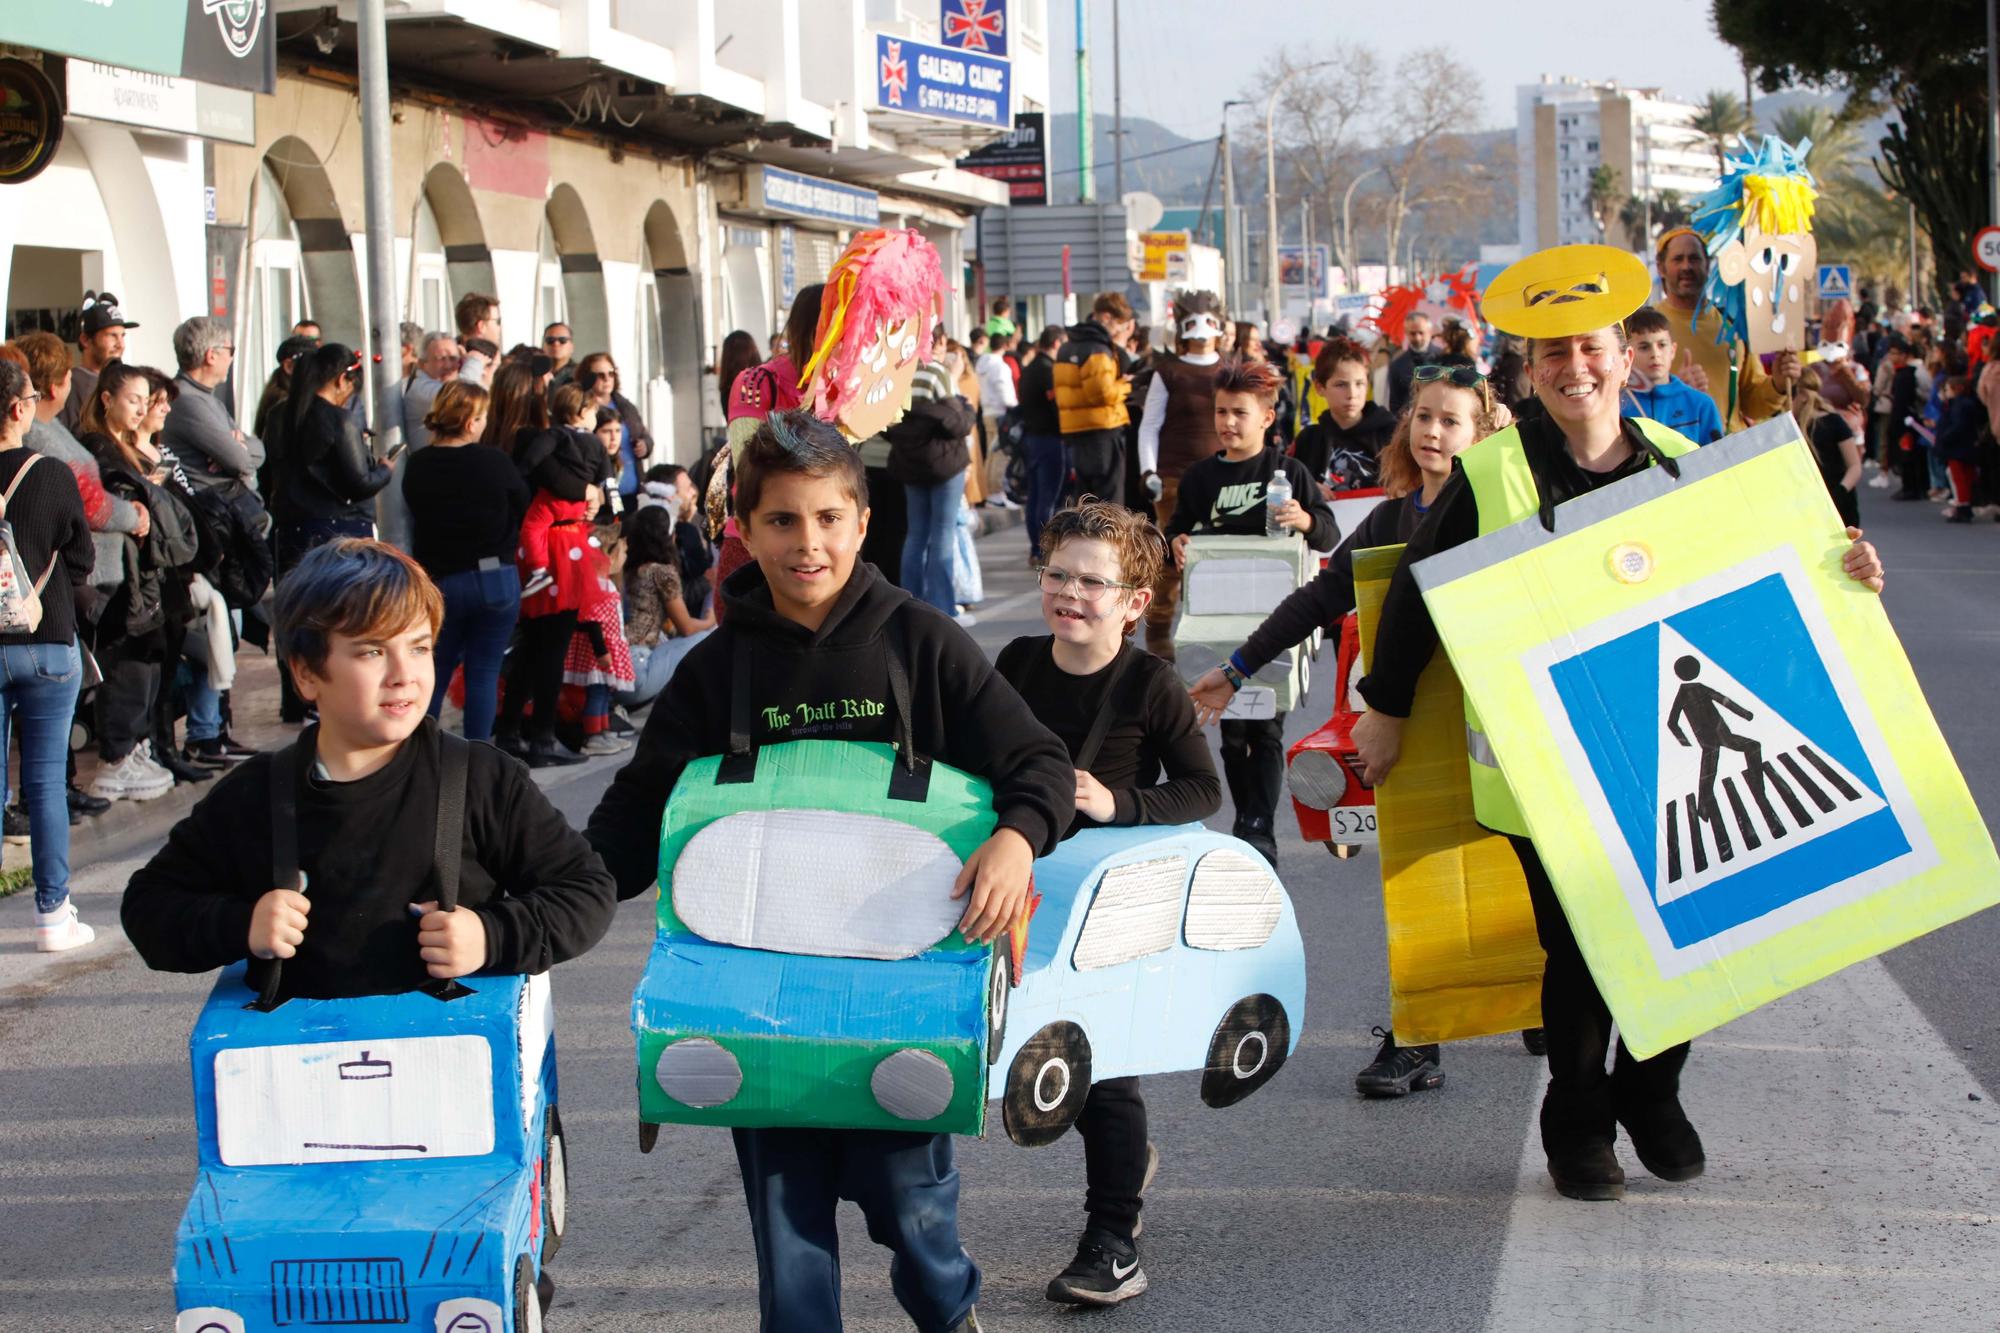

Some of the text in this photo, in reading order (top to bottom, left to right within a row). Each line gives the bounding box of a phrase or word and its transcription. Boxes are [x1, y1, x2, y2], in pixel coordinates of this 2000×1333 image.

[918, 54, 1003, 93] GALENO CLINIC
[1216, 481, 1262, 509] NIKE
[761, 698, 885, 732] The Half Ride
